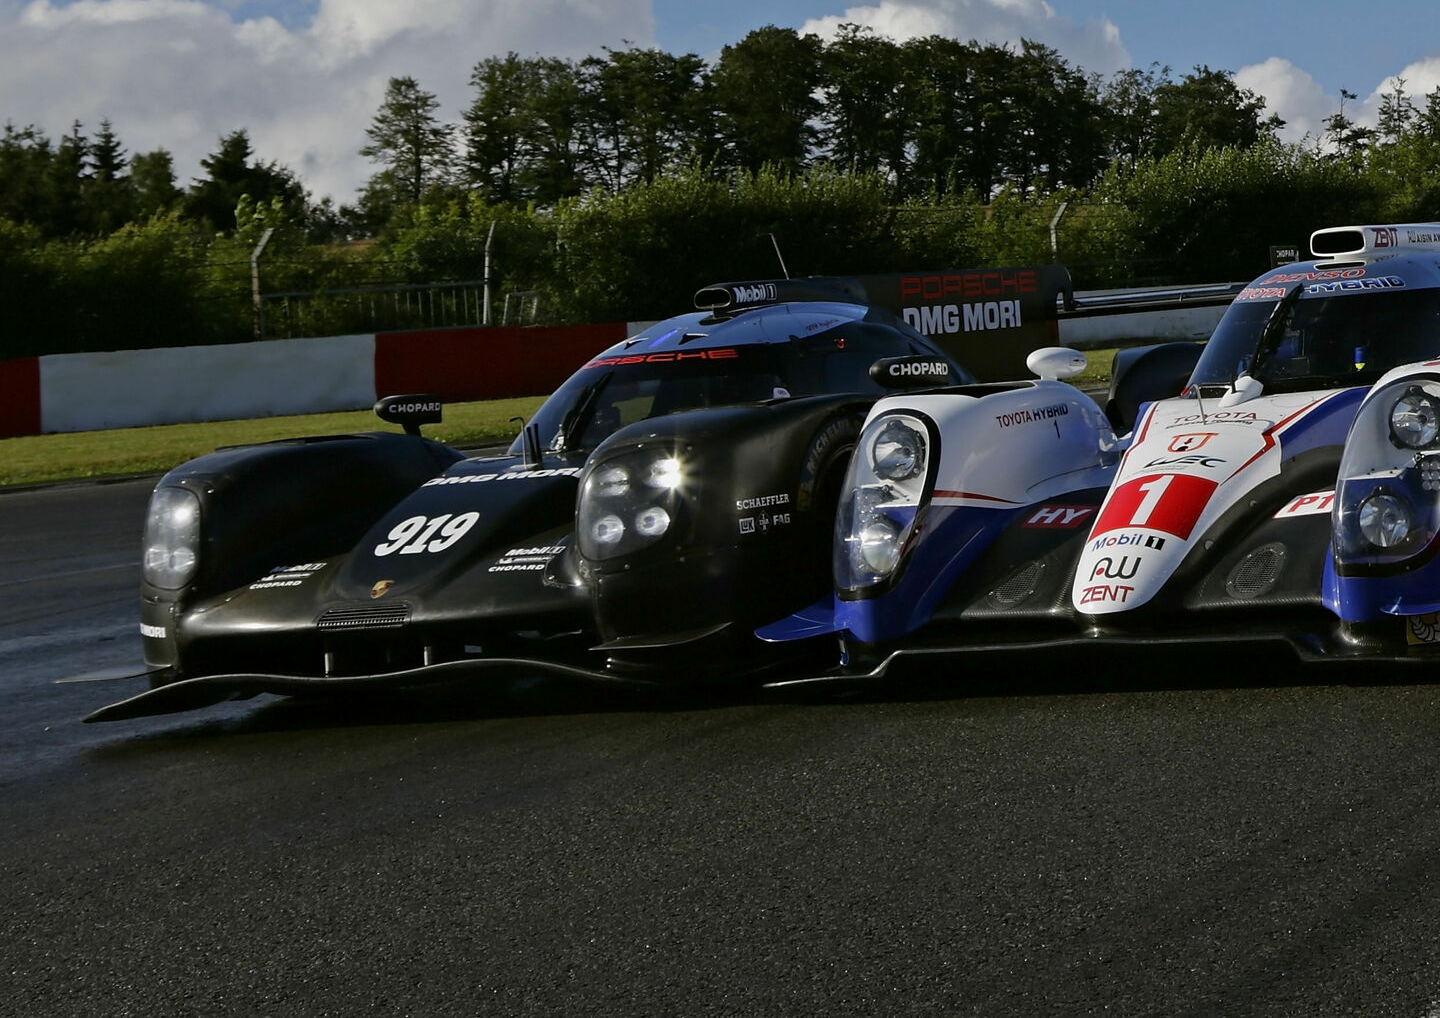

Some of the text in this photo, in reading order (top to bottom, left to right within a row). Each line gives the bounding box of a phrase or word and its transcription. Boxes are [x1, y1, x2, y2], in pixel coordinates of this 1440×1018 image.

[1371, 228, 1398, 248] ZENT
[733, 284, 766, 303] Mobil
[902, 270, 1038, 300] PORSCHE
[902, 299, 1022, 335] DMG MORI
[582, 349, 739, 370] ORSCHE
[888, 362, 949, 377] CHOPARD
[388, 402, 441, 413] CHOPARD
[996, 403, 1069, 428] TOYOTA HYBRID
[1174, 412, 1257, 424] TOYOTA
[1053, 419, 1061, 439] 1
[736, 493, 790, 510] SCHAEFFLER
[1128, 474, 1176, 525] 1
[773, 513, 790, 525] FAG
[1027, 508, 1093, 524] HY
[374, 511, 480, 557] 919
[1092, 534, 1142, 552] Mobil
[505, 546, 549, 556] Mobil
[488, 564, 545, 572] CHOPARD
[249, 580, 303, 590] CHOPARD
[1080, 585, 1135, 604] ZENT
